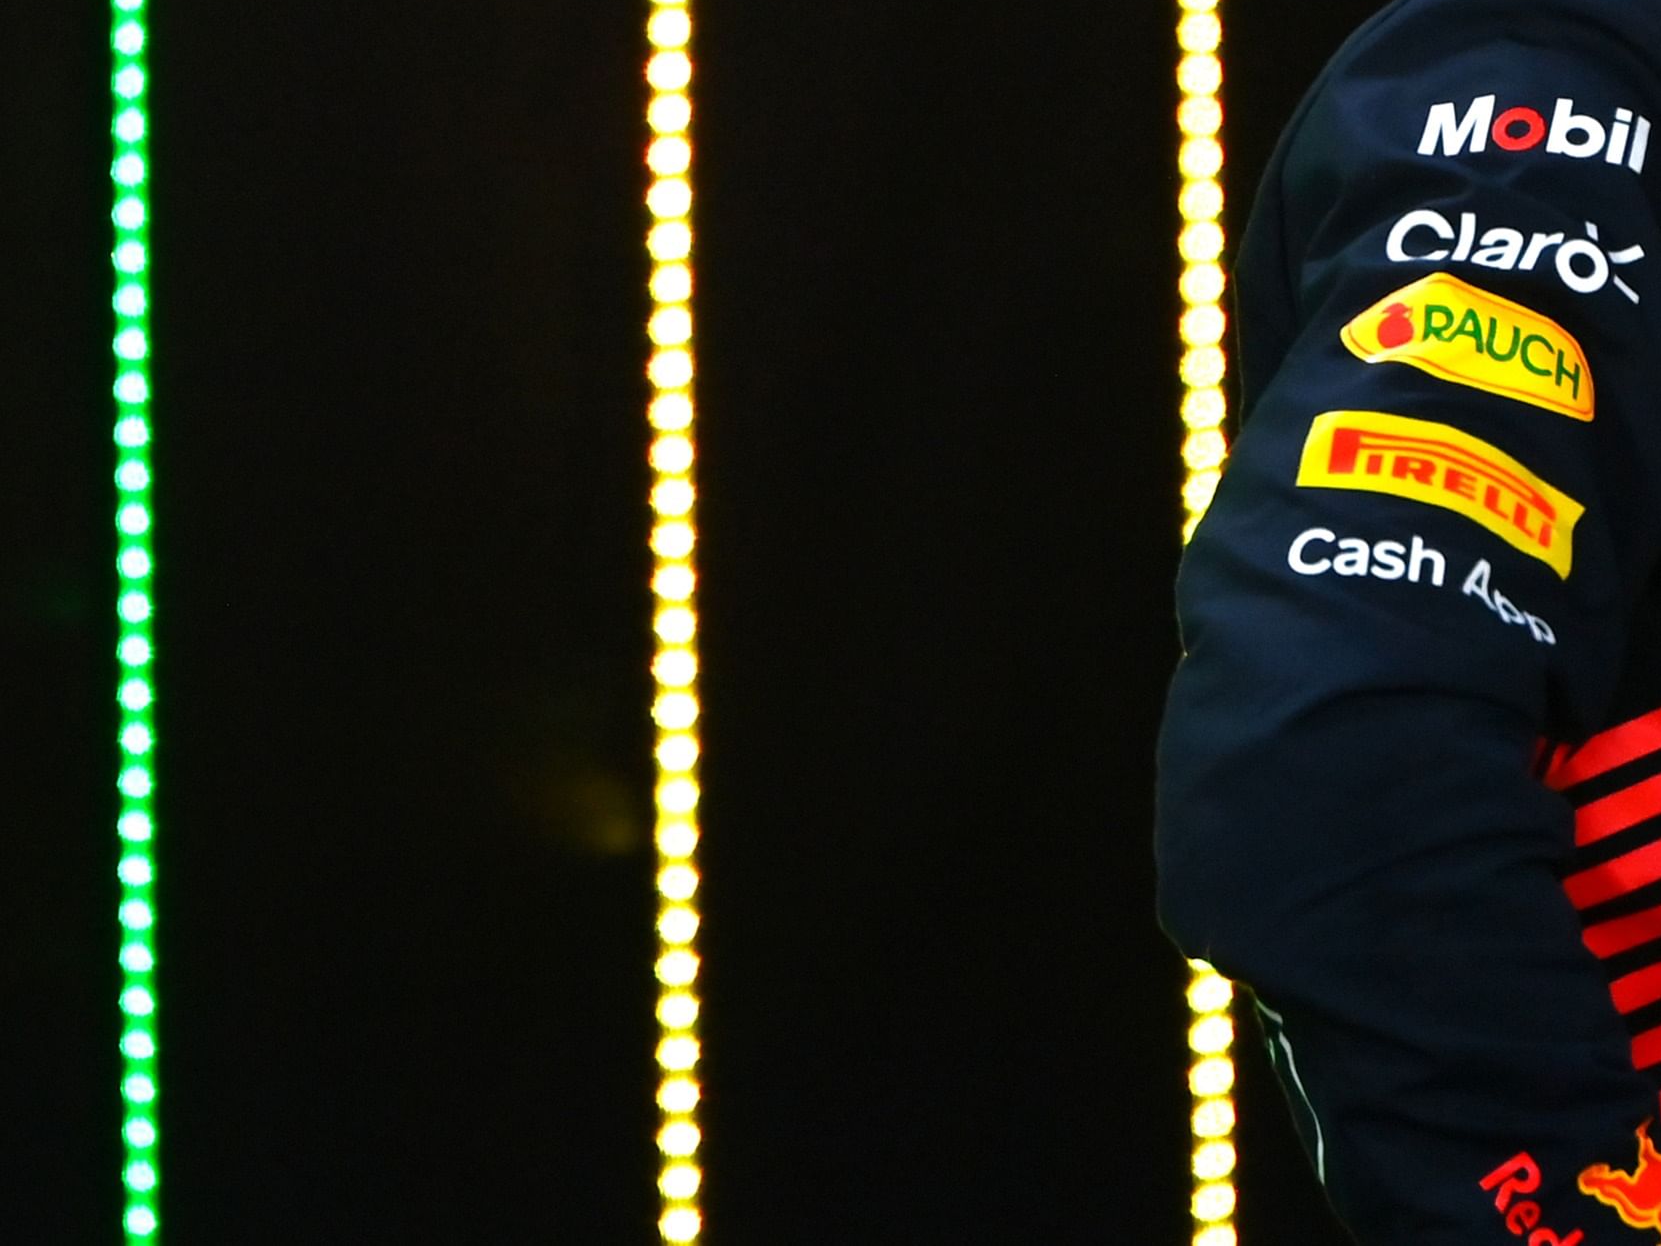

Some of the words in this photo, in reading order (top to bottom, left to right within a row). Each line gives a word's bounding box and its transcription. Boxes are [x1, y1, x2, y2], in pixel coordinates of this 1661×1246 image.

[1417, 94, 1651, 174] Mobil
[1422, 303, 1581, 400] RAUCH
[1327, 426, 1557, 550] PIRELLI
[1287, 527, 1446, 588] Cash
[1462, 558, 1557, 646] App
